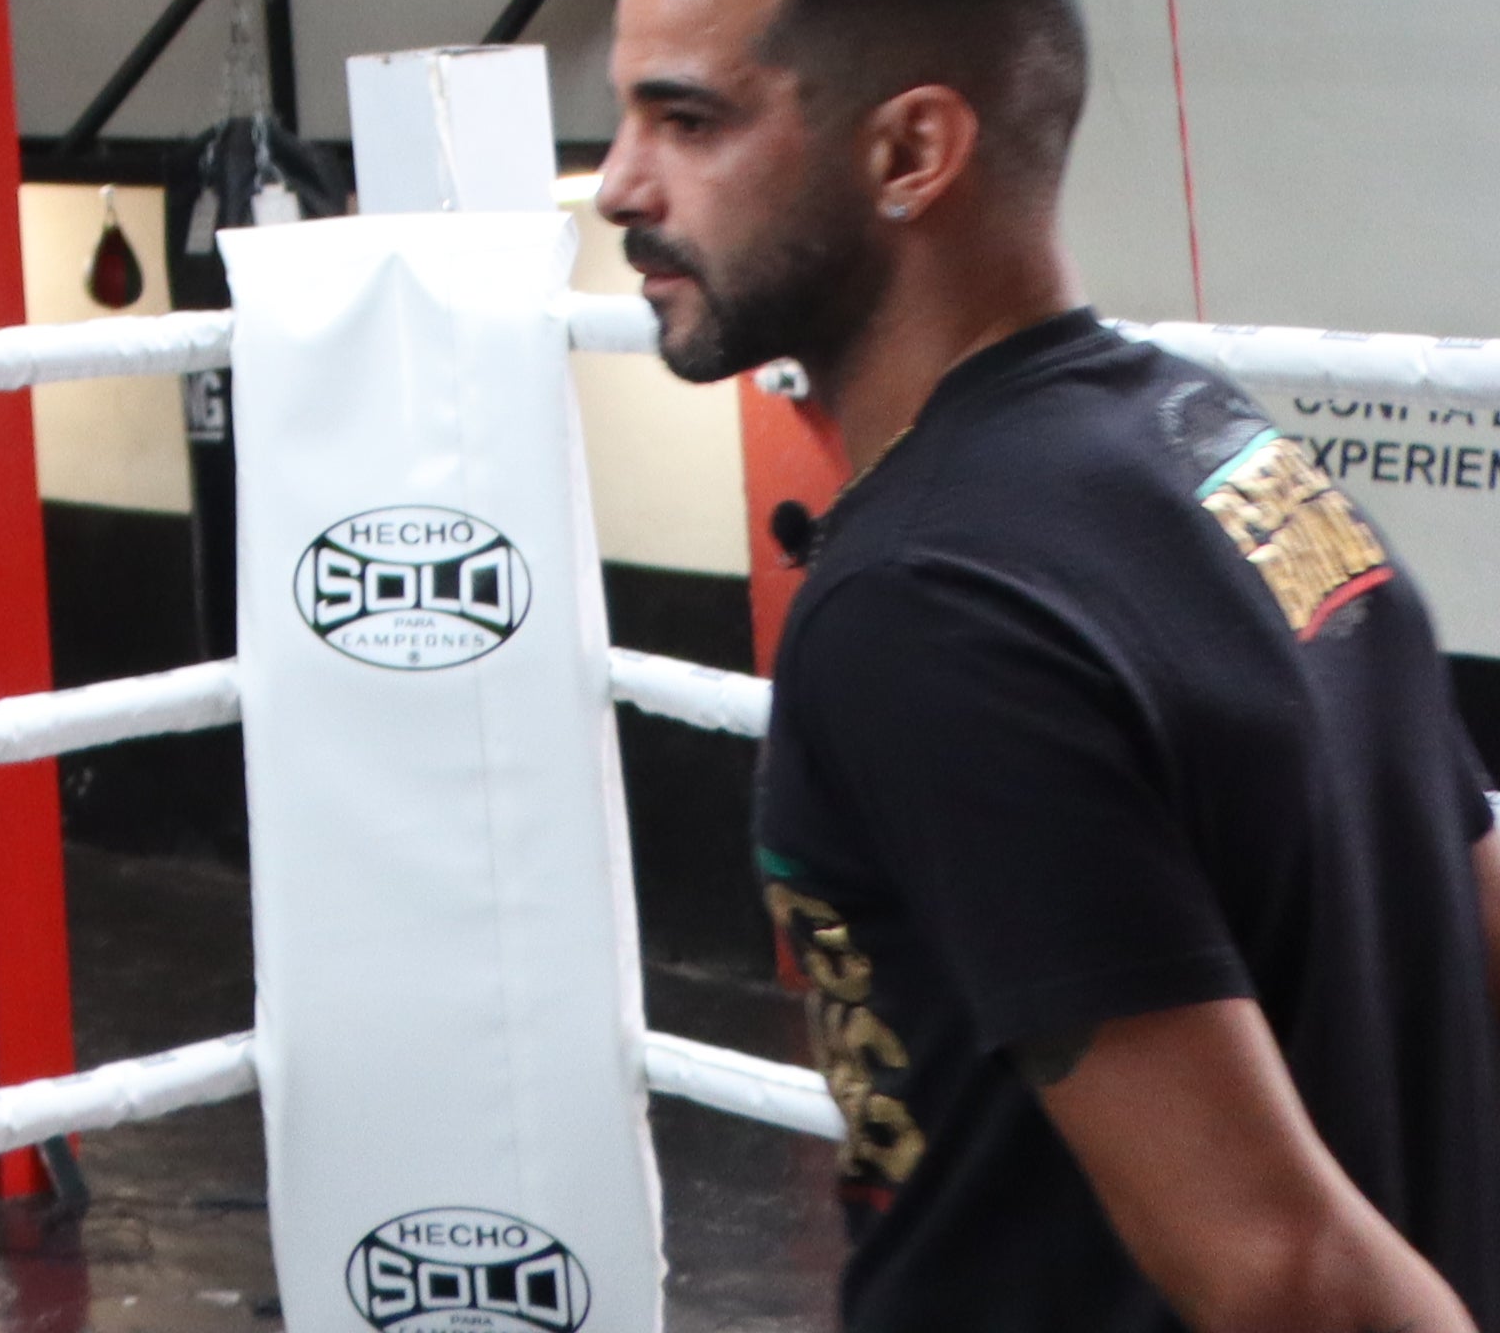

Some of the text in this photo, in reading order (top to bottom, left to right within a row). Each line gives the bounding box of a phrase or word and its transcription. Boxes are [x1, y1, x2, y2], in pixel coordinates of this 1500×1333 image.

[349, 520, 474, 545] HECHO
[316, 545, 511, 627] SOLO
[394, 616, 436, 629] PARA
[341, 632, 485, 648] CAMPEONES
[399, 1223, 527, 1248] HECHO
[369, 1245, 571, 1328] SOLO
